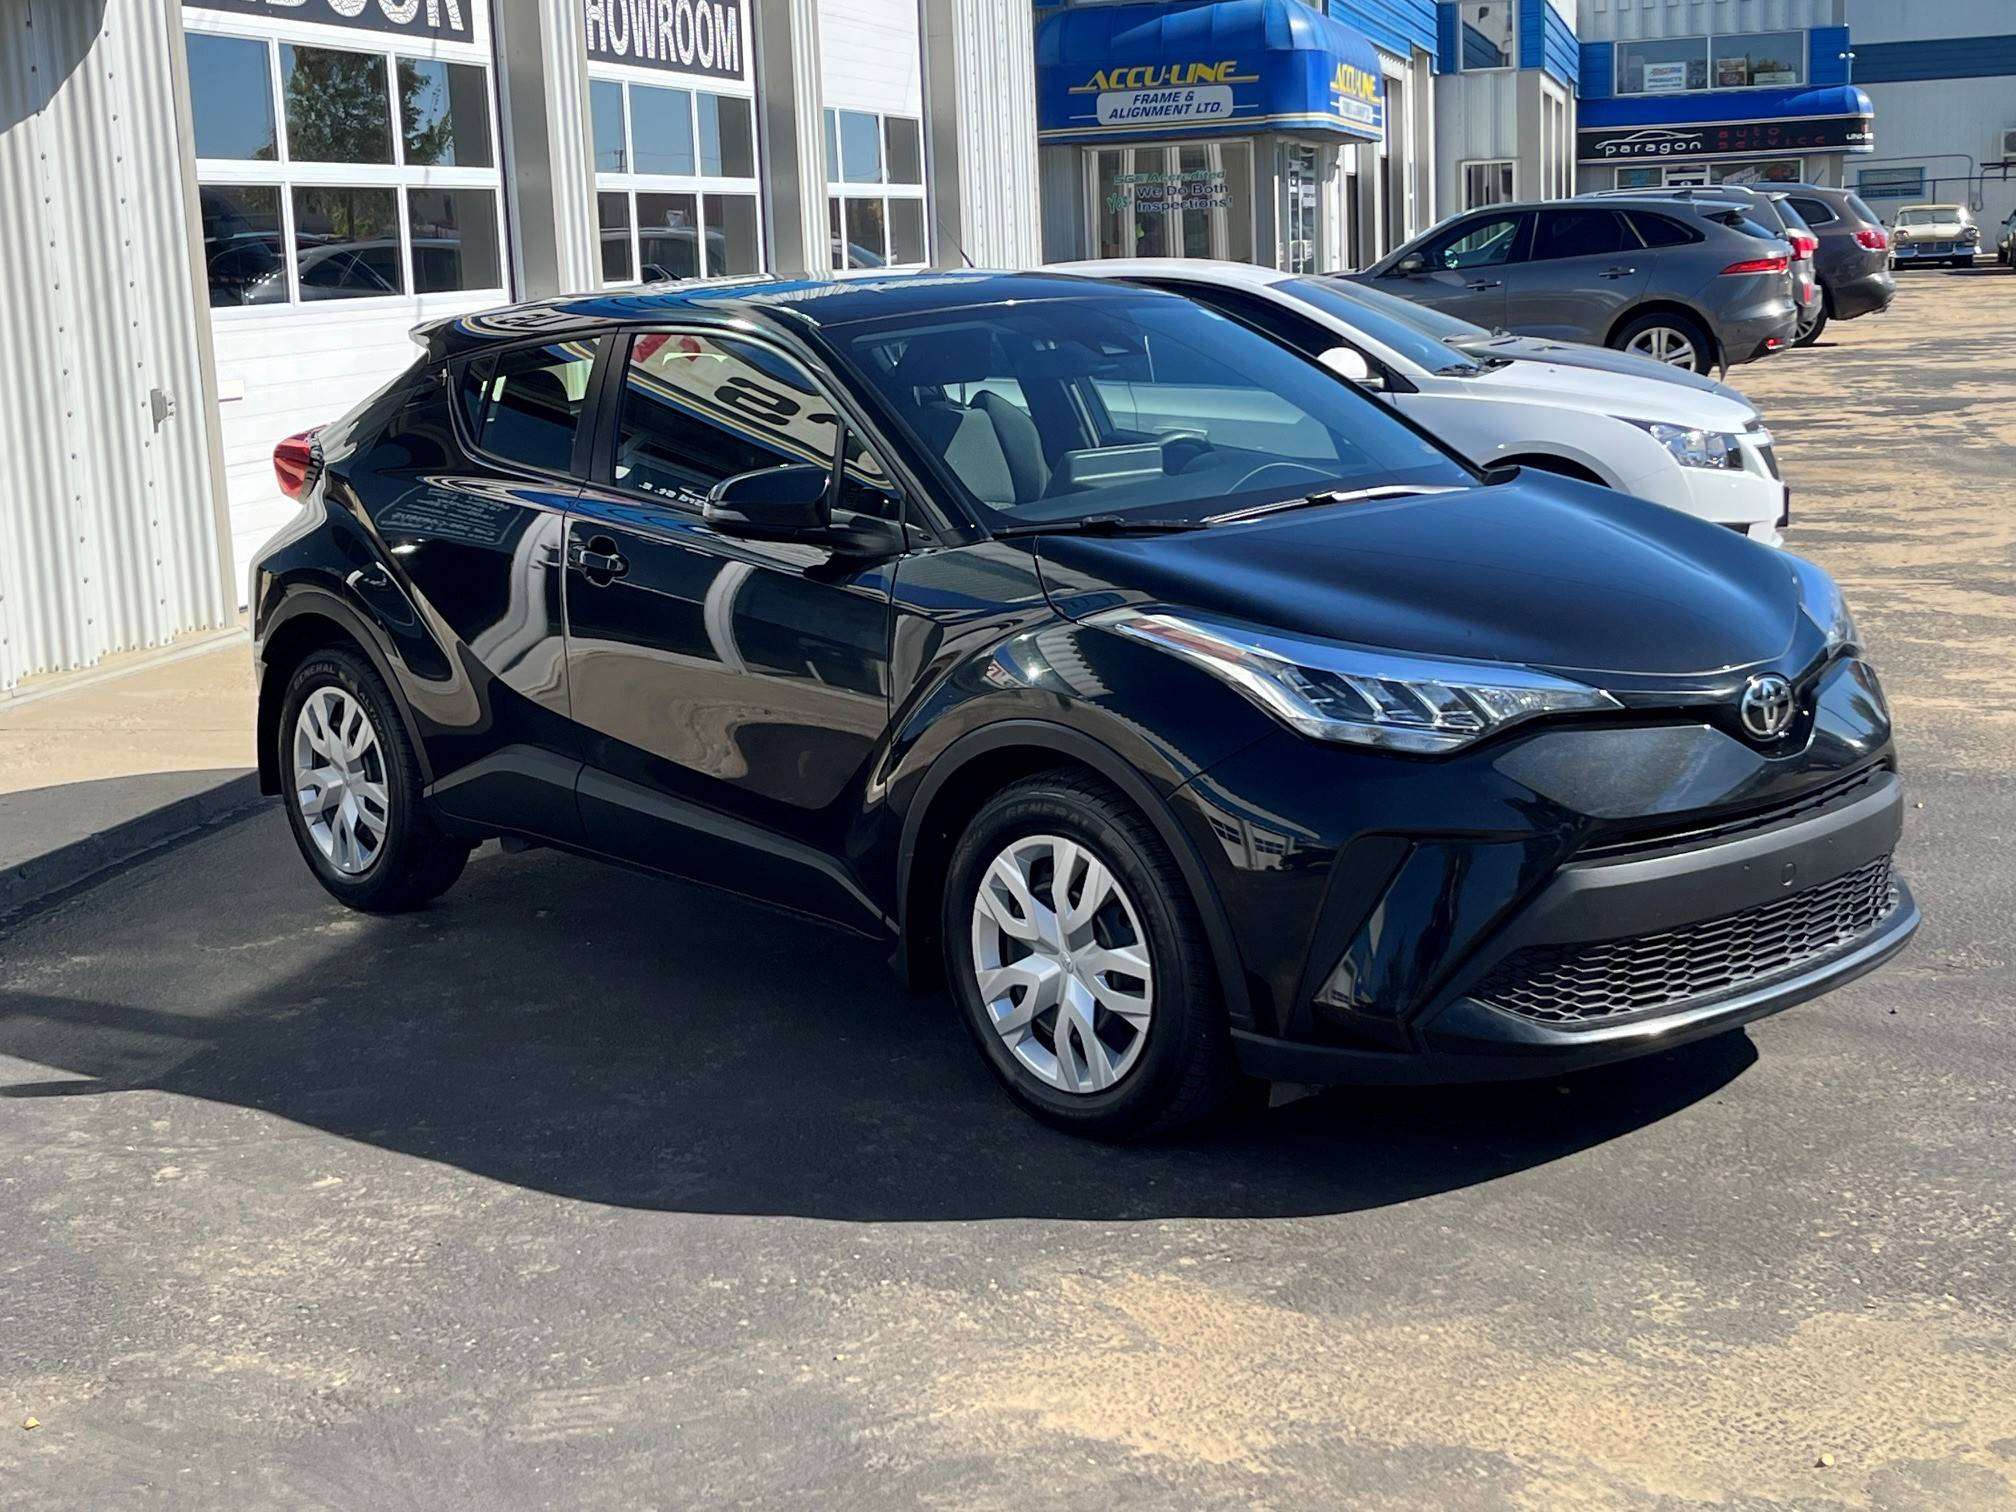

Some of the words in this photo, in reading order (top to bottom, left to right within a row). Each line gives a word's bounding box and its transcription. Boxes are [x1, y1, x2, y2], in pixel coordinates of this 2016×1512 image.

[583, 0, 739, 72] HOWROOM
[1133, 92, 1182, 106] FRAME
[1185, 91, 1195, 102] &
[1109, 104, 1192, 120] ALIGNMENT
[1195, 102, 1224, 114] LTD.
[1605, 140, 1701, 157] paragon
[1137, 186, 1162, 198] We
[1166, 185, 1188, 196] Do
[1192, 183, 1229, 195] Both
